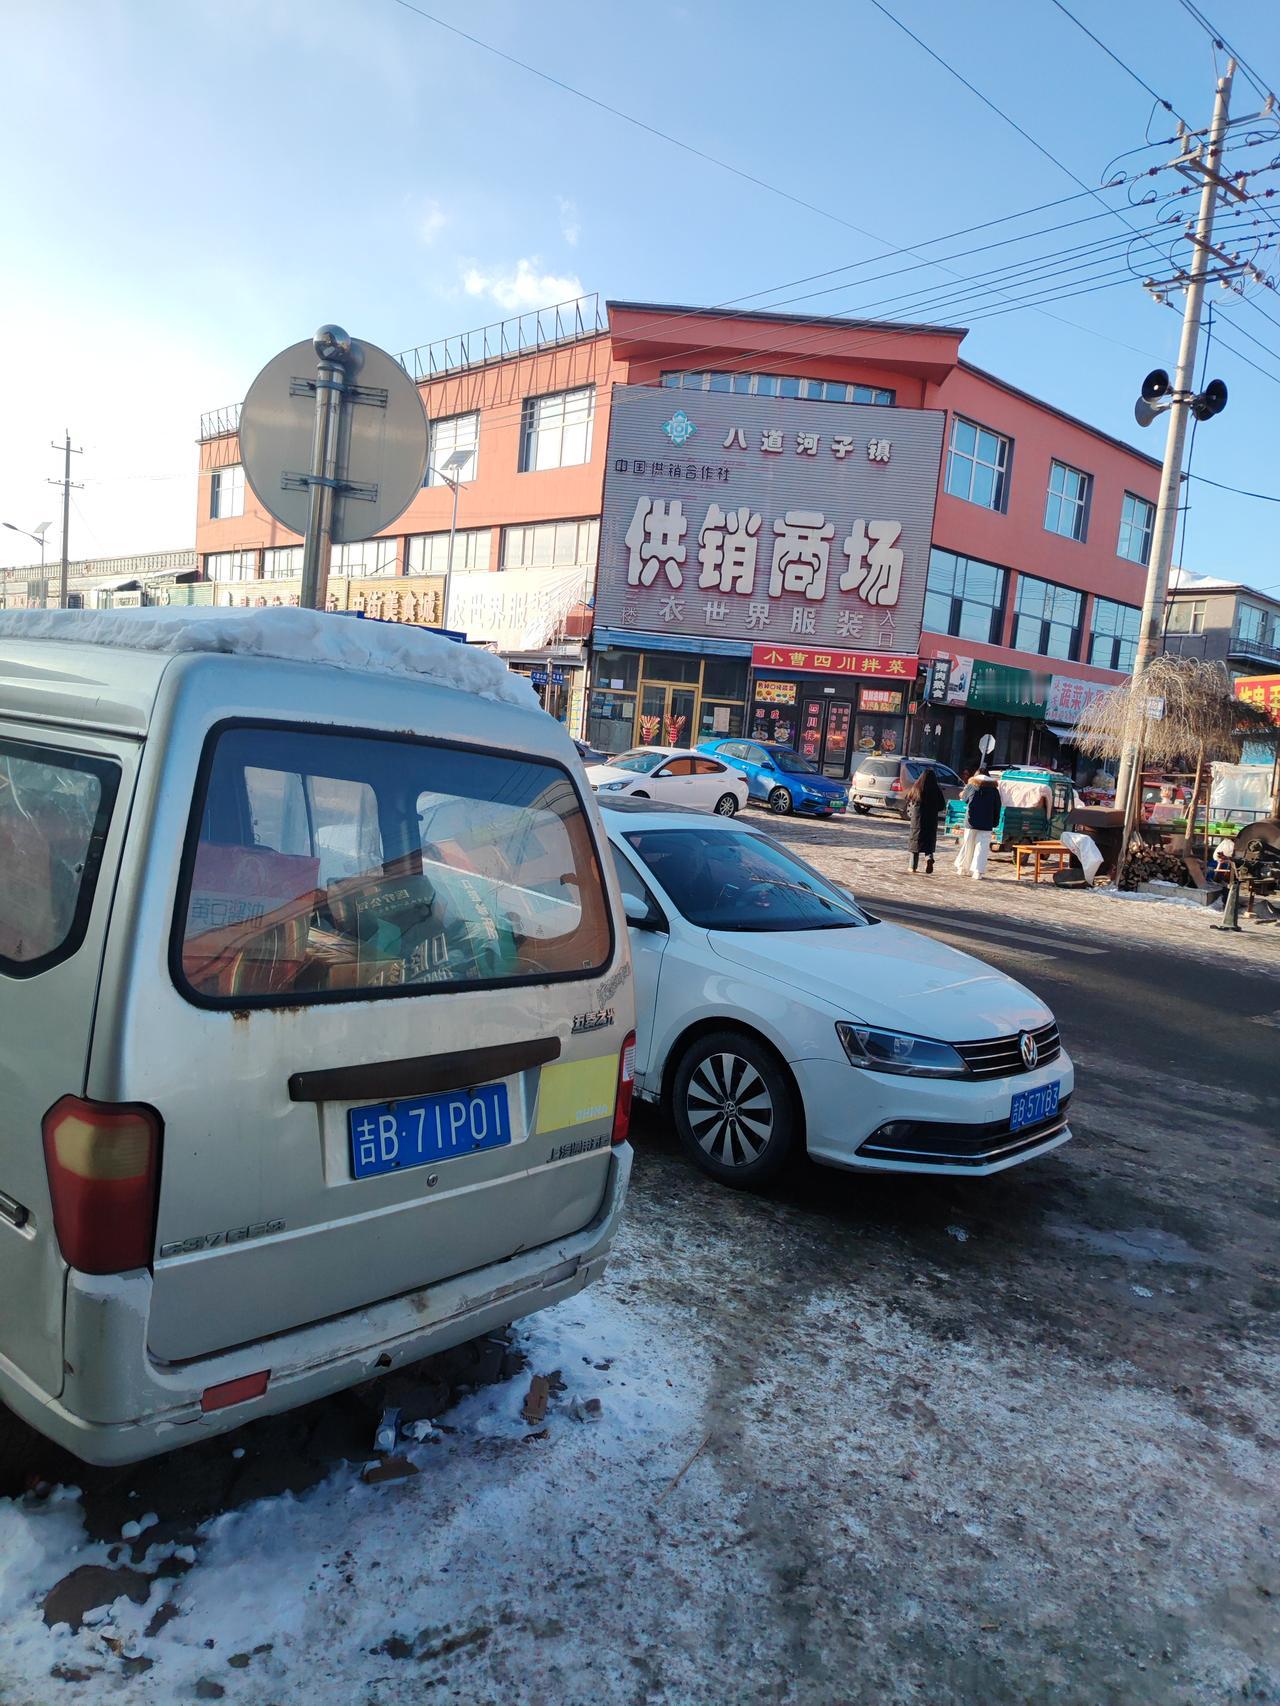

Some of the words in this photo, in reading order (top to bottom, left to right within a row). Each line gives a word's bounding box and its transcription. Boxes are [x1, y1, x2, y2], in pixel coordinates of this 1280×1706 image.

[722, 427, 893, 462] 八道河子镇
[614, 457, 731, 483] 中国供销合作社
[624, 495, 904, 607] 供销商场
[658, 594, 864, 639] 衣世界服装
[877, 609, 896, 649] 入口
[763, 650, 906, 674] 小曹四川拌菜
